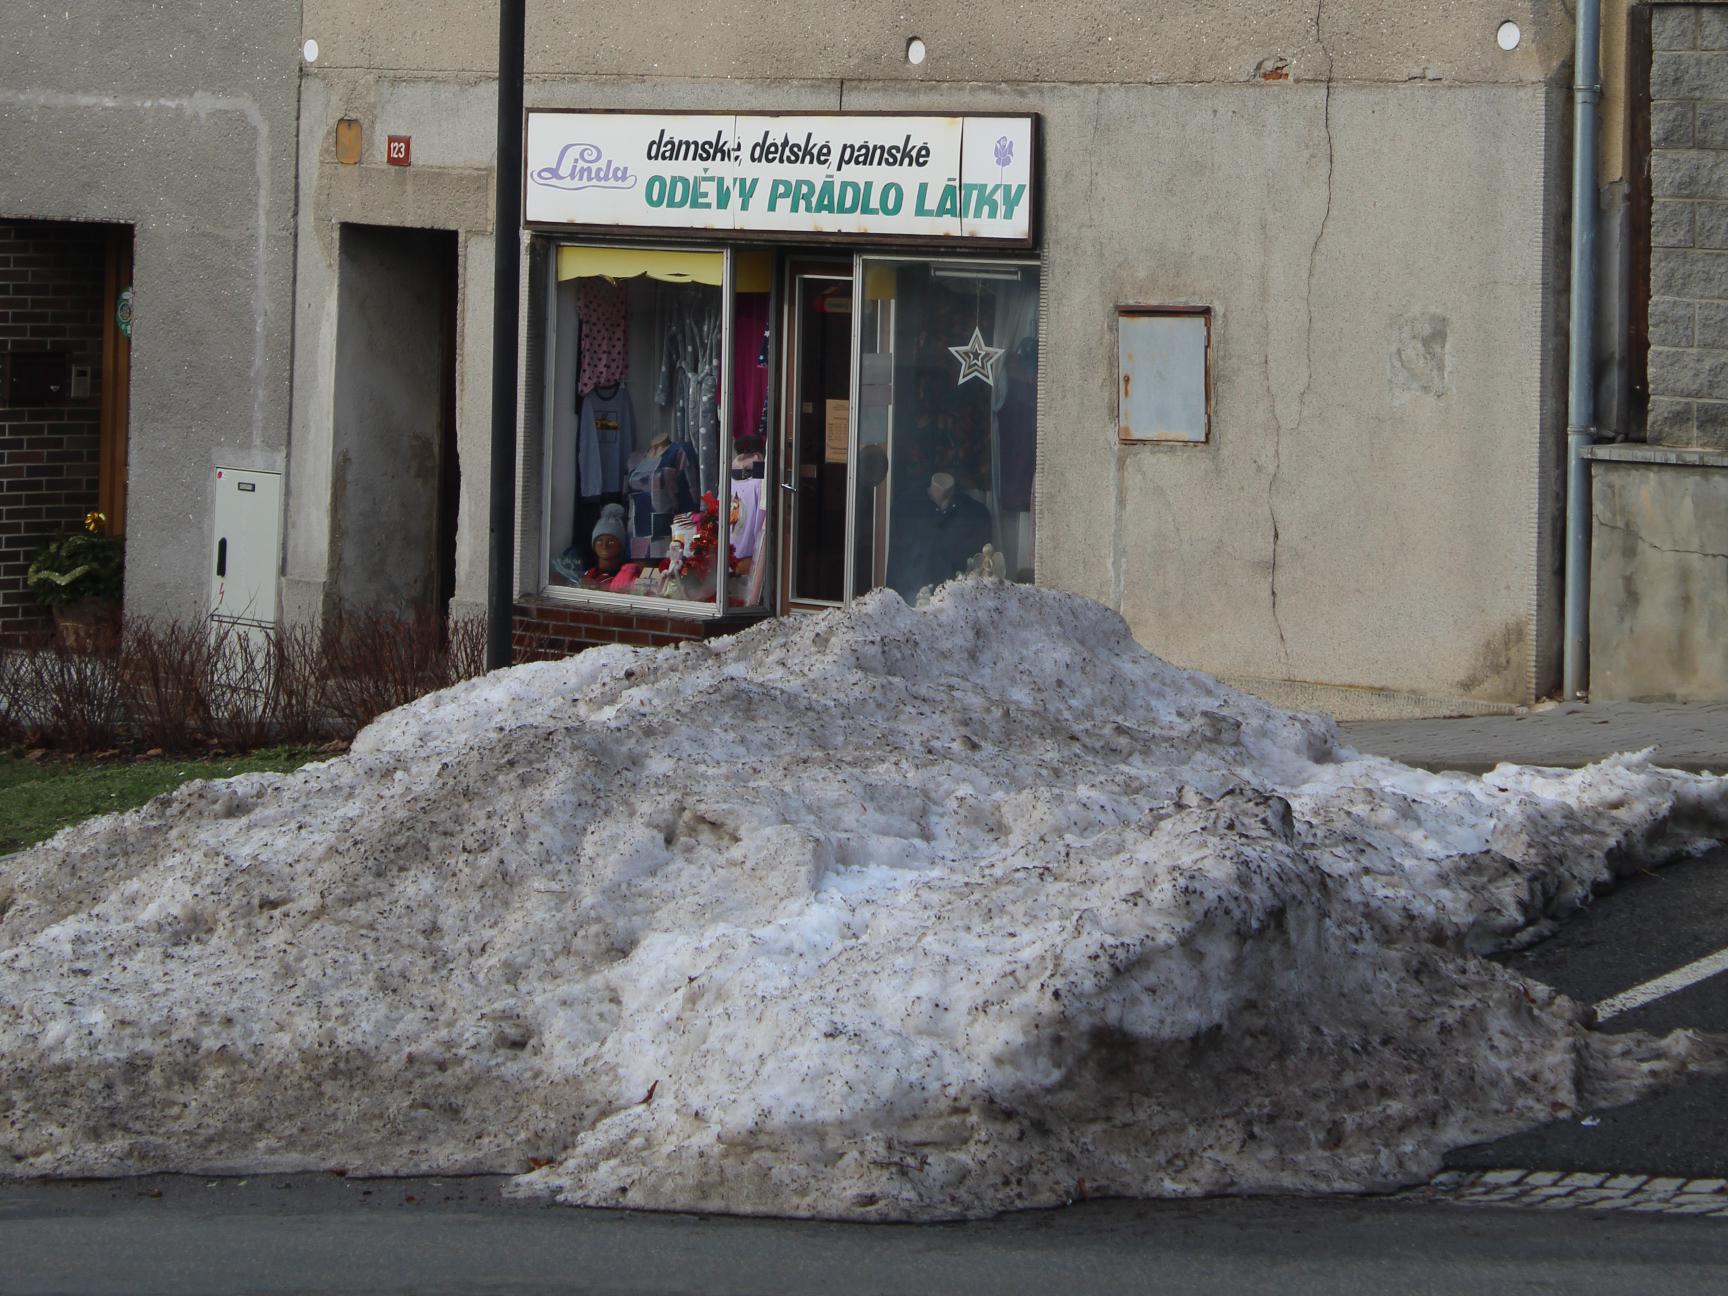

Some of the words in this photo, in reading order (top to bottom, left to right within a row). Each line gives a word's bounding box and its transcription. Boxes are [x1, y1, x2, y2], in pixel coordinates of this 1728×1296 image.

[390, 142, 405, 158] 123
[532, 143, 635, 189] Linda
[836, 134, 931, 171] pánské
[645, 167, 760, 212] ODĚVY
[767, 174, 904, 217] PRÁDLO
[914, 177, 1027, 220] LÁTKY
